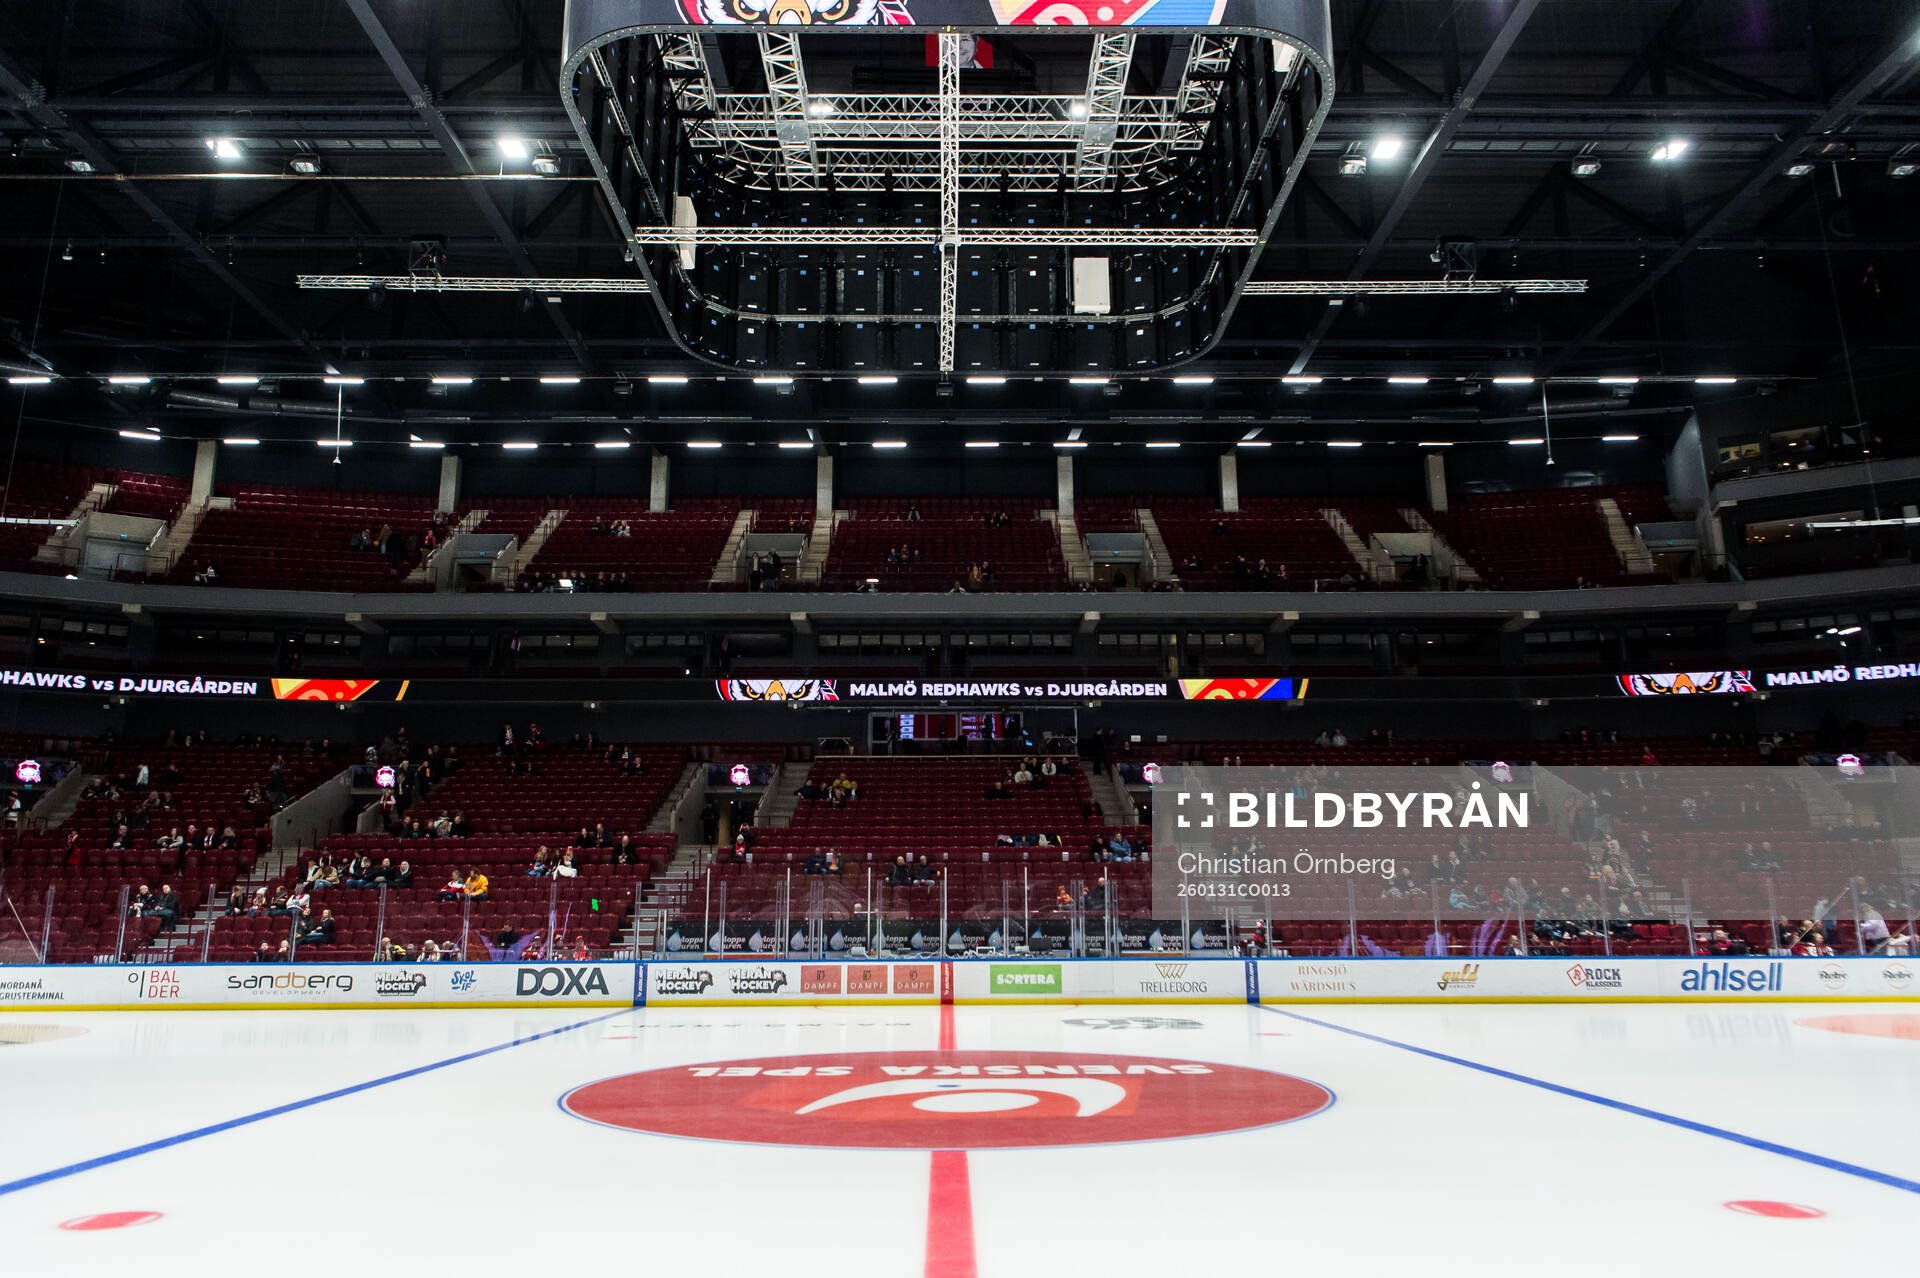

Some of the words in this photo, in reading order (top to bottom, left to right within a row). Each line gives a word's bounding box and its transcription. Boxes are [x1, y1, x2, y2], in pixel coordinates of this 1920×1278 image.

[1766, 665, 1850, 686] MALMÖ
[0, 671, 86, 689] HAWKS
[91, 680, 115, 691] vs
[120, 676, 257, 694] DJURGÅRDEN
[850, 680, 918, 696] MALMÖ
[922, 683, 1020, 696] REDHAWKS
[1024, 686, 1044, 696] vs
[1047, 680, 1168, 696] DJURGÅRDEN
[151, 970, 180, 983] BAL
[997, 974, 1056, 985] SORTERA
[1585, 968, 1621, 980] ROCK
[1681, 962, 1783, 991] ahlsell
[228, 972, 353, 991] sandberg
[376, 982, 417, 991] HOCKEY
[516, 967, 609, 996] DOXA
[657, 980, 703, 991] HOCKEY
[731, 980, 777, 990] HOCKEY
[1140, 981, 1208, 993] TRELLEBORG
[148, 985, 180, 998] DER
[688, 1066, 854, 1077] SPEL
[880, 1065, 1214, 1076] SVENSKA
